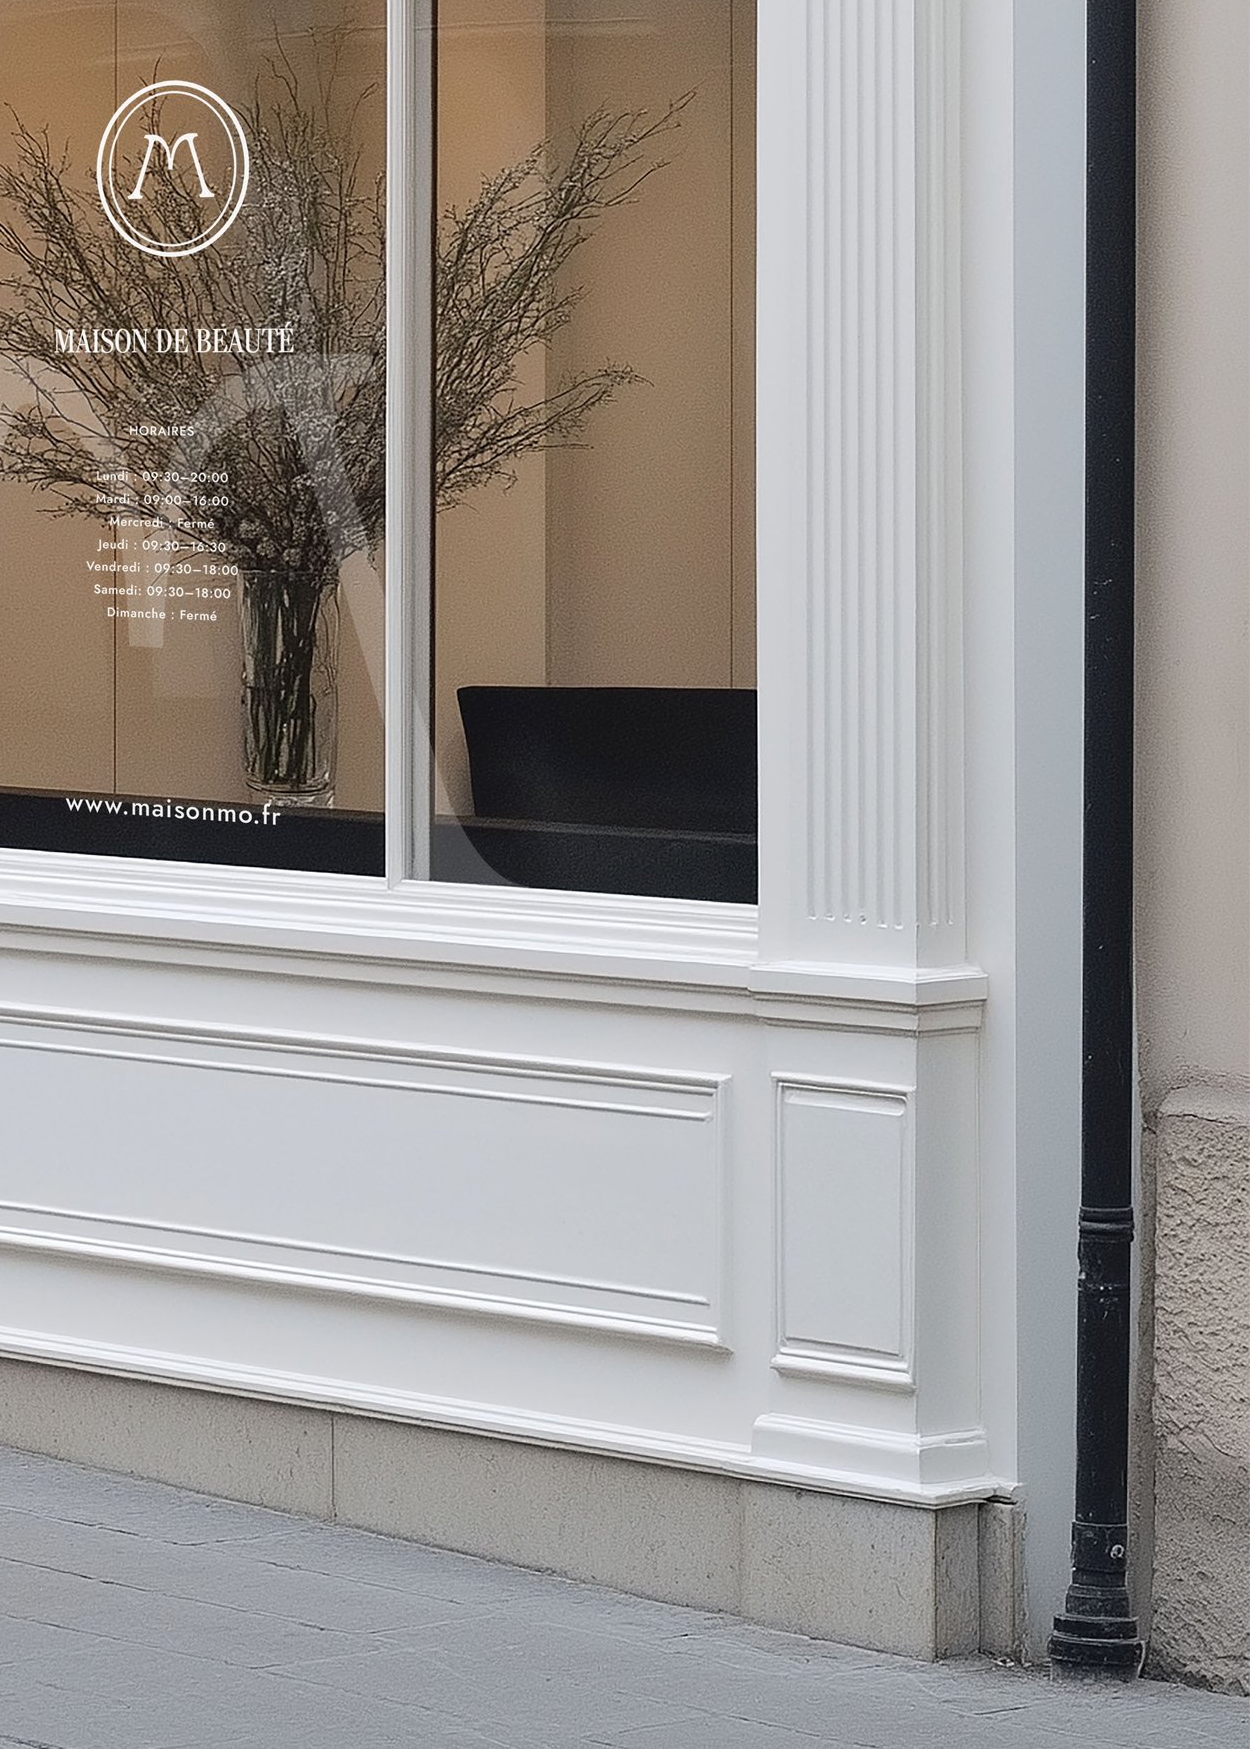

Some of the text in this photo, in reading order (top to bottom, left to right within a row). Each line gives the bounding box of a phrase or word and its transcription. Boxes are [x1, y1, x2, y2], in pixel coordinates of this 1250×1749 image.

[127, 132, 215, 200] M
[54, 321, 295, 354] MAISON DE BEAUTÉ
[128, 425, 195, 437] HORAIRES
[95, 470, 129, 482] Lundi
[95, 494, 131, 505] Mardi
[109, 516, 163, 528] Mercredi
[177, 516, 215, 529] Fermé
[96, 538, 129, 552] Jeudi
[86, 561, 141, 573] Vendredi
[93, 584, 142, 596] Samedi:
[107, 607, 166, 620] Dimanche
[179, 609, 218, 622] Fermé
[65, 797, 282, 826] www.maisonmo.fr
